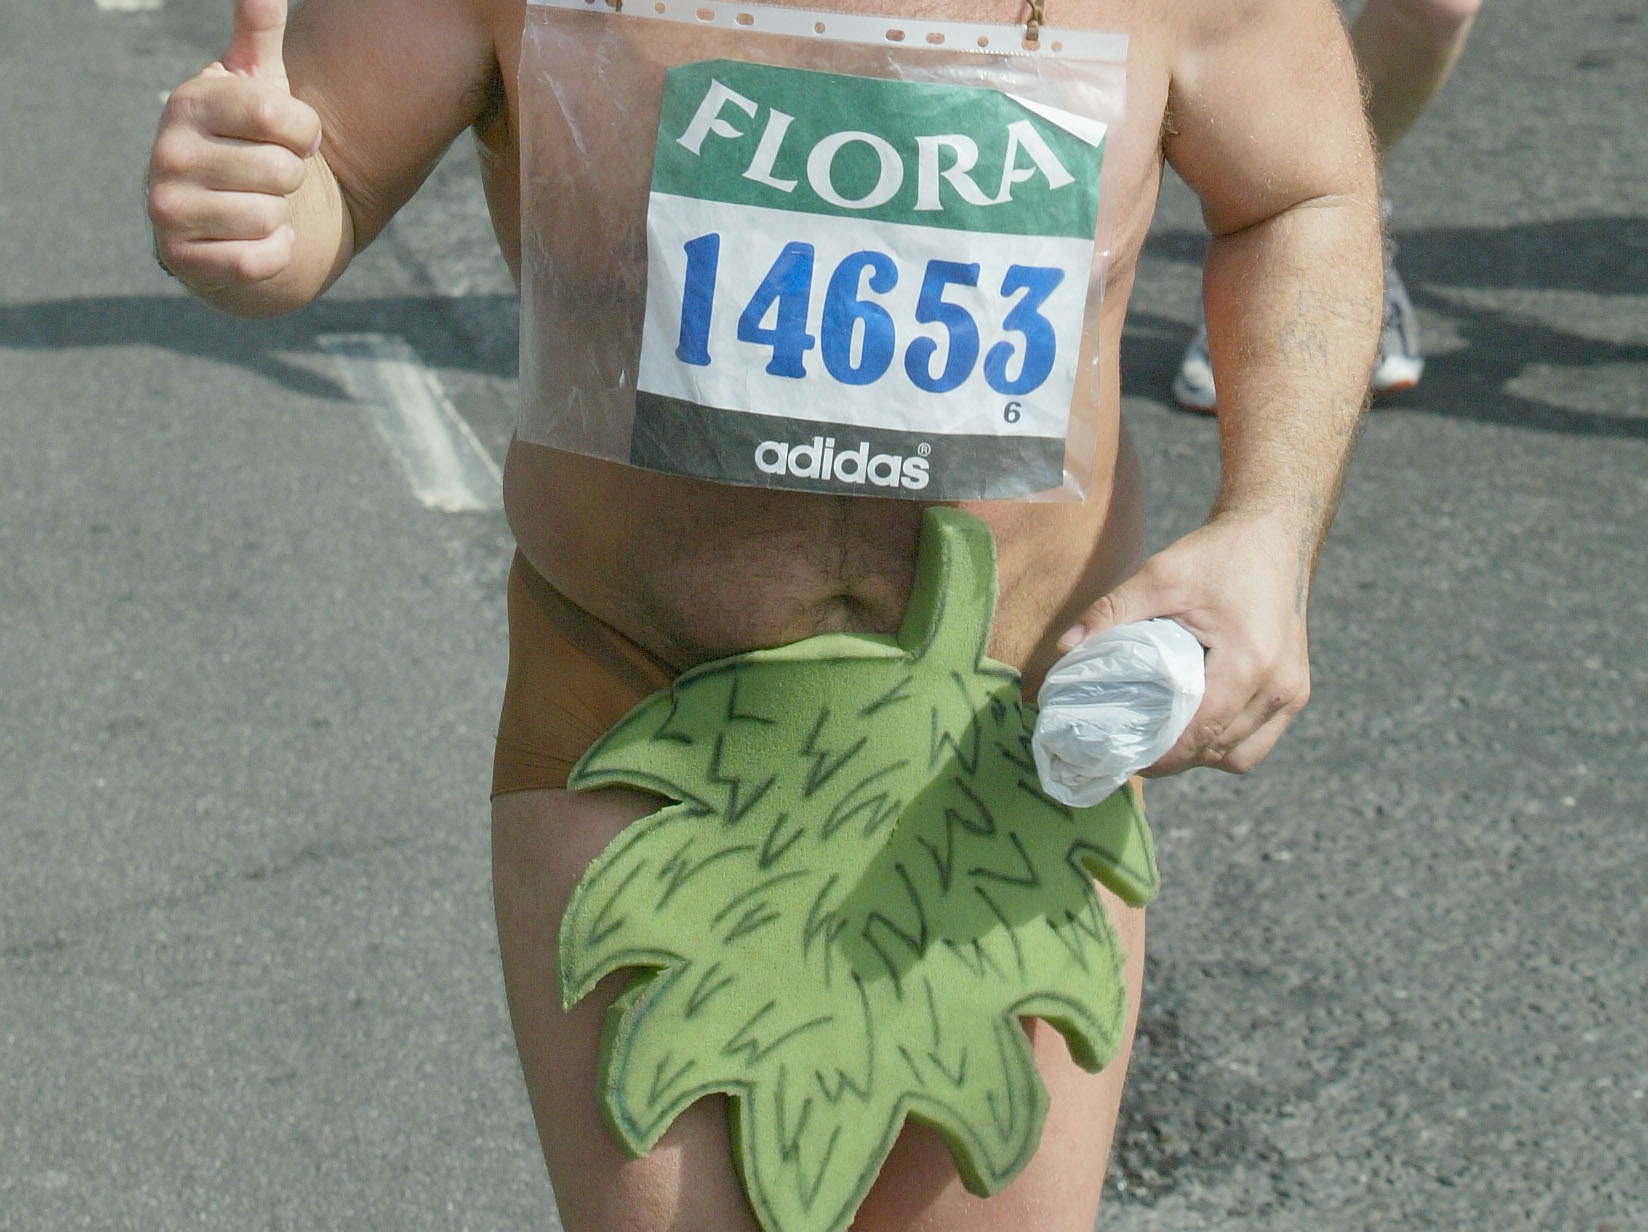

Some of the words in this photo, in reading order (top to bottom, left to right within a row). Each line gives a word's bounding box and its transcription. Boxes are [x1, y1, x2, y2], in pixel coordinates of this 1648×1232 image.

[675, 78, 1076, 211] FLORA
[675, 232, 1066, 396] 14653
[1003, 401, 1022, 423] 6
